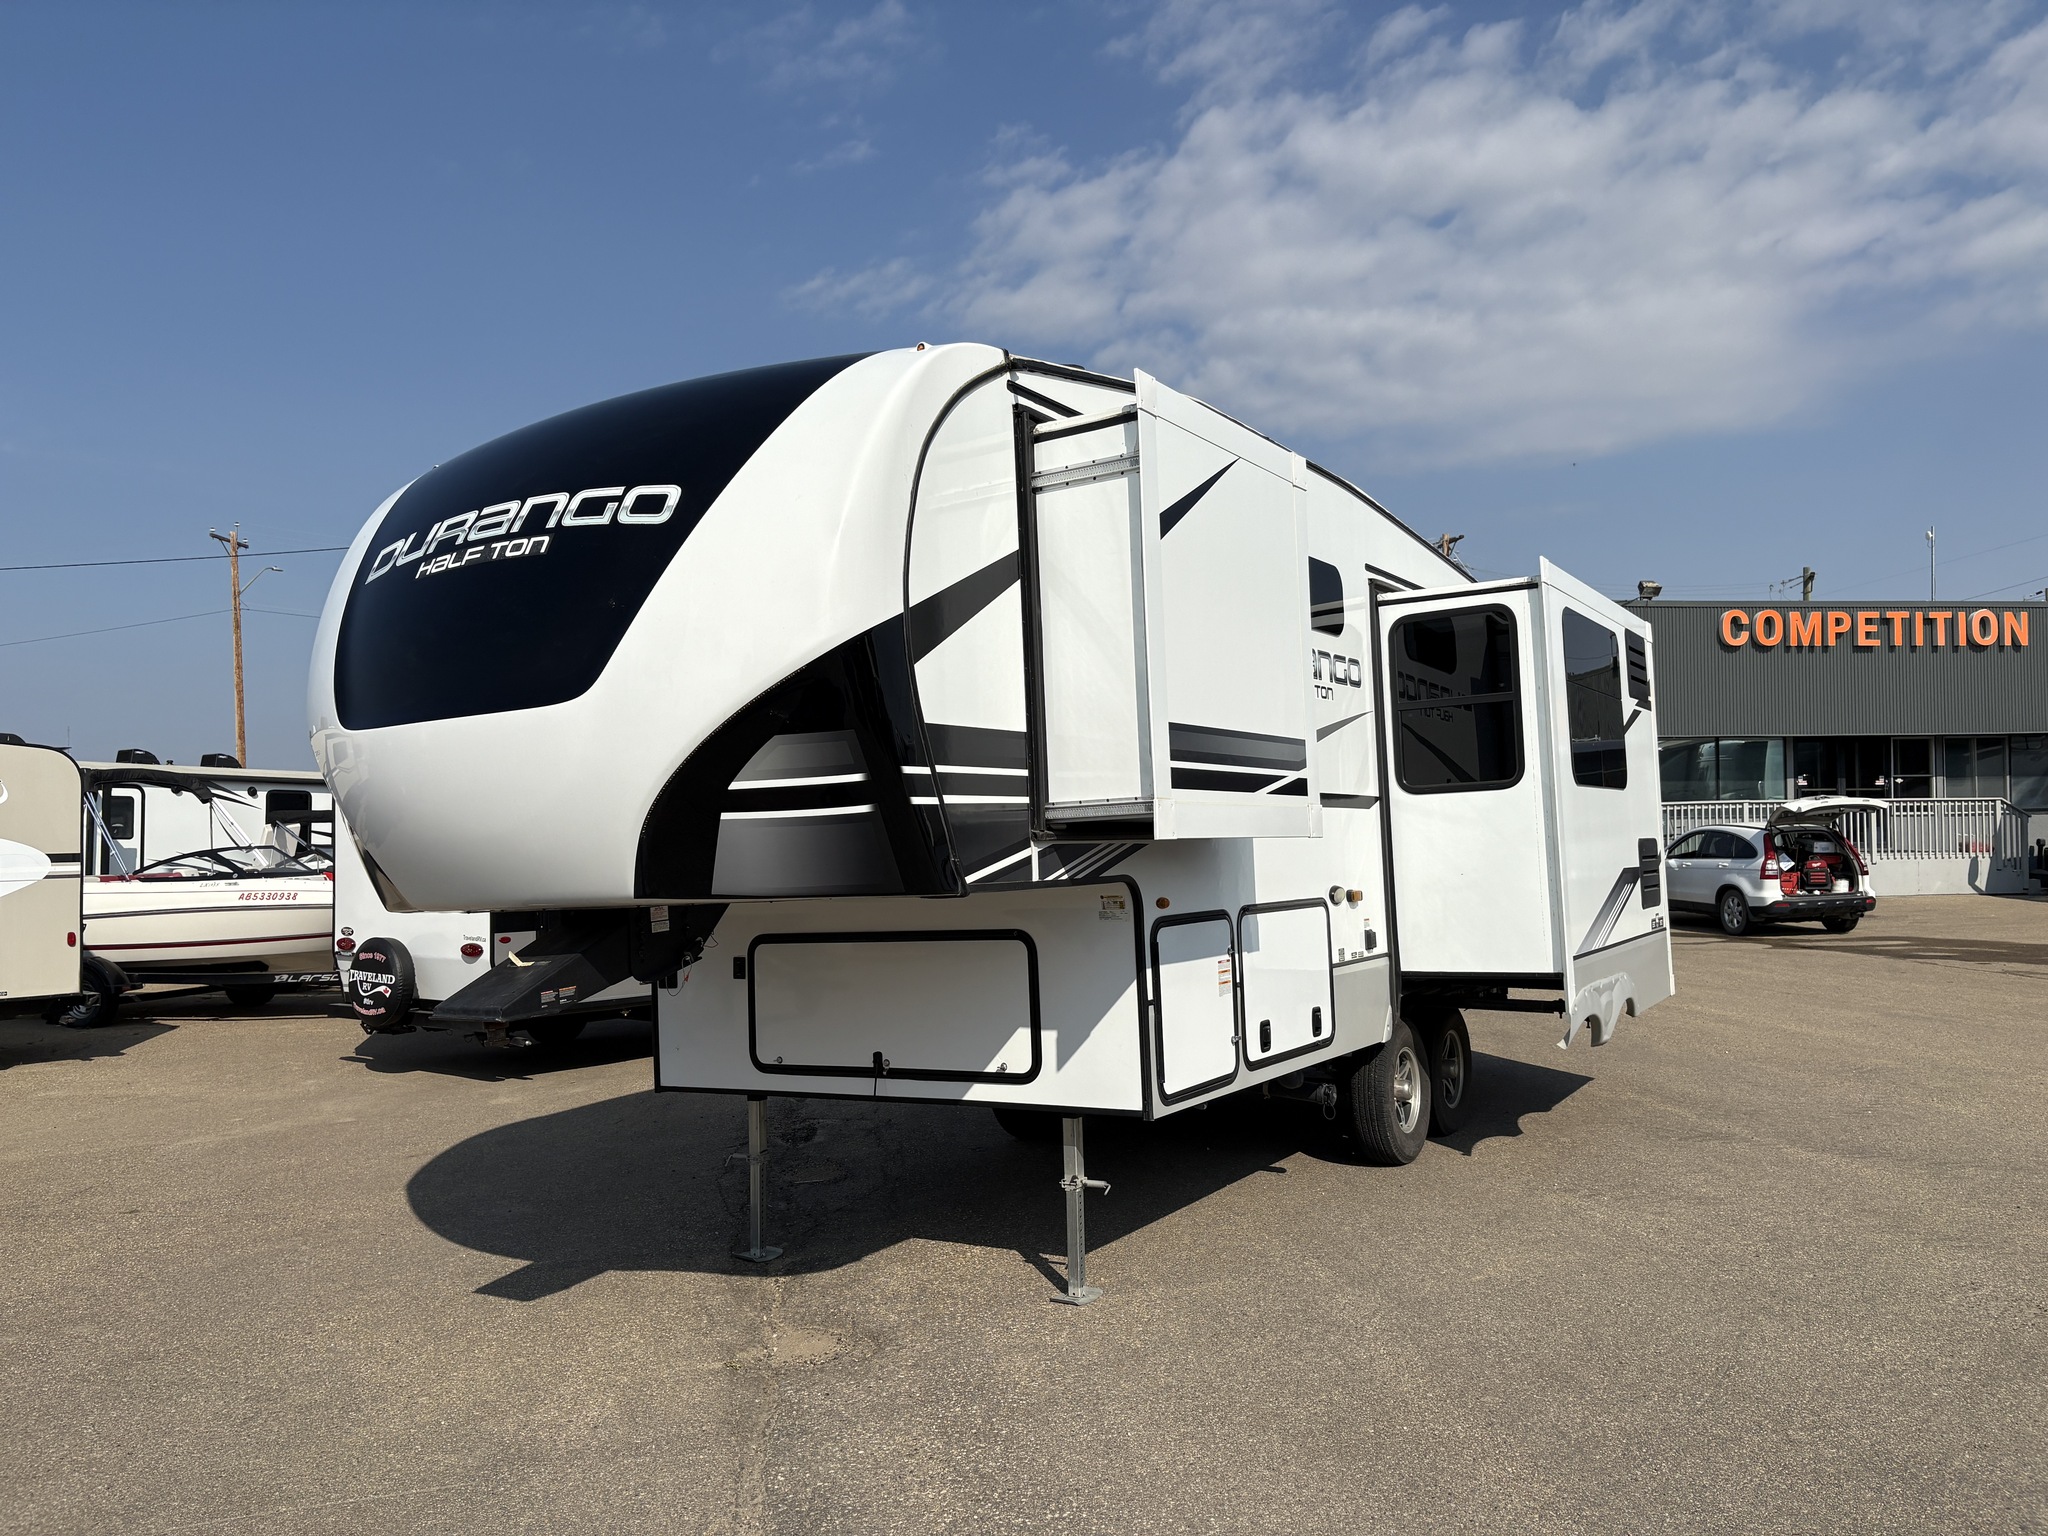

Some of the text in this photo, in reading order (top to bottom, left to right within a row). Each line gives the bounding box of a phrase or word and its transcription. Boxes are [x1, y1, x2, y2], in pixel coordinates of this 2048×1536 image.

[365, 484, 682, 585] DURANGO
[415, 535, 550, 579] HALF TON
[1719, 608, 2029, 647] COMPETITION
[1314, 684, 1333, 700] TON
[238, 892, 299, 901] AB5330938
[349, 968, 396, 985] TRAVELAND
[362, 982, 372, 991] RV
